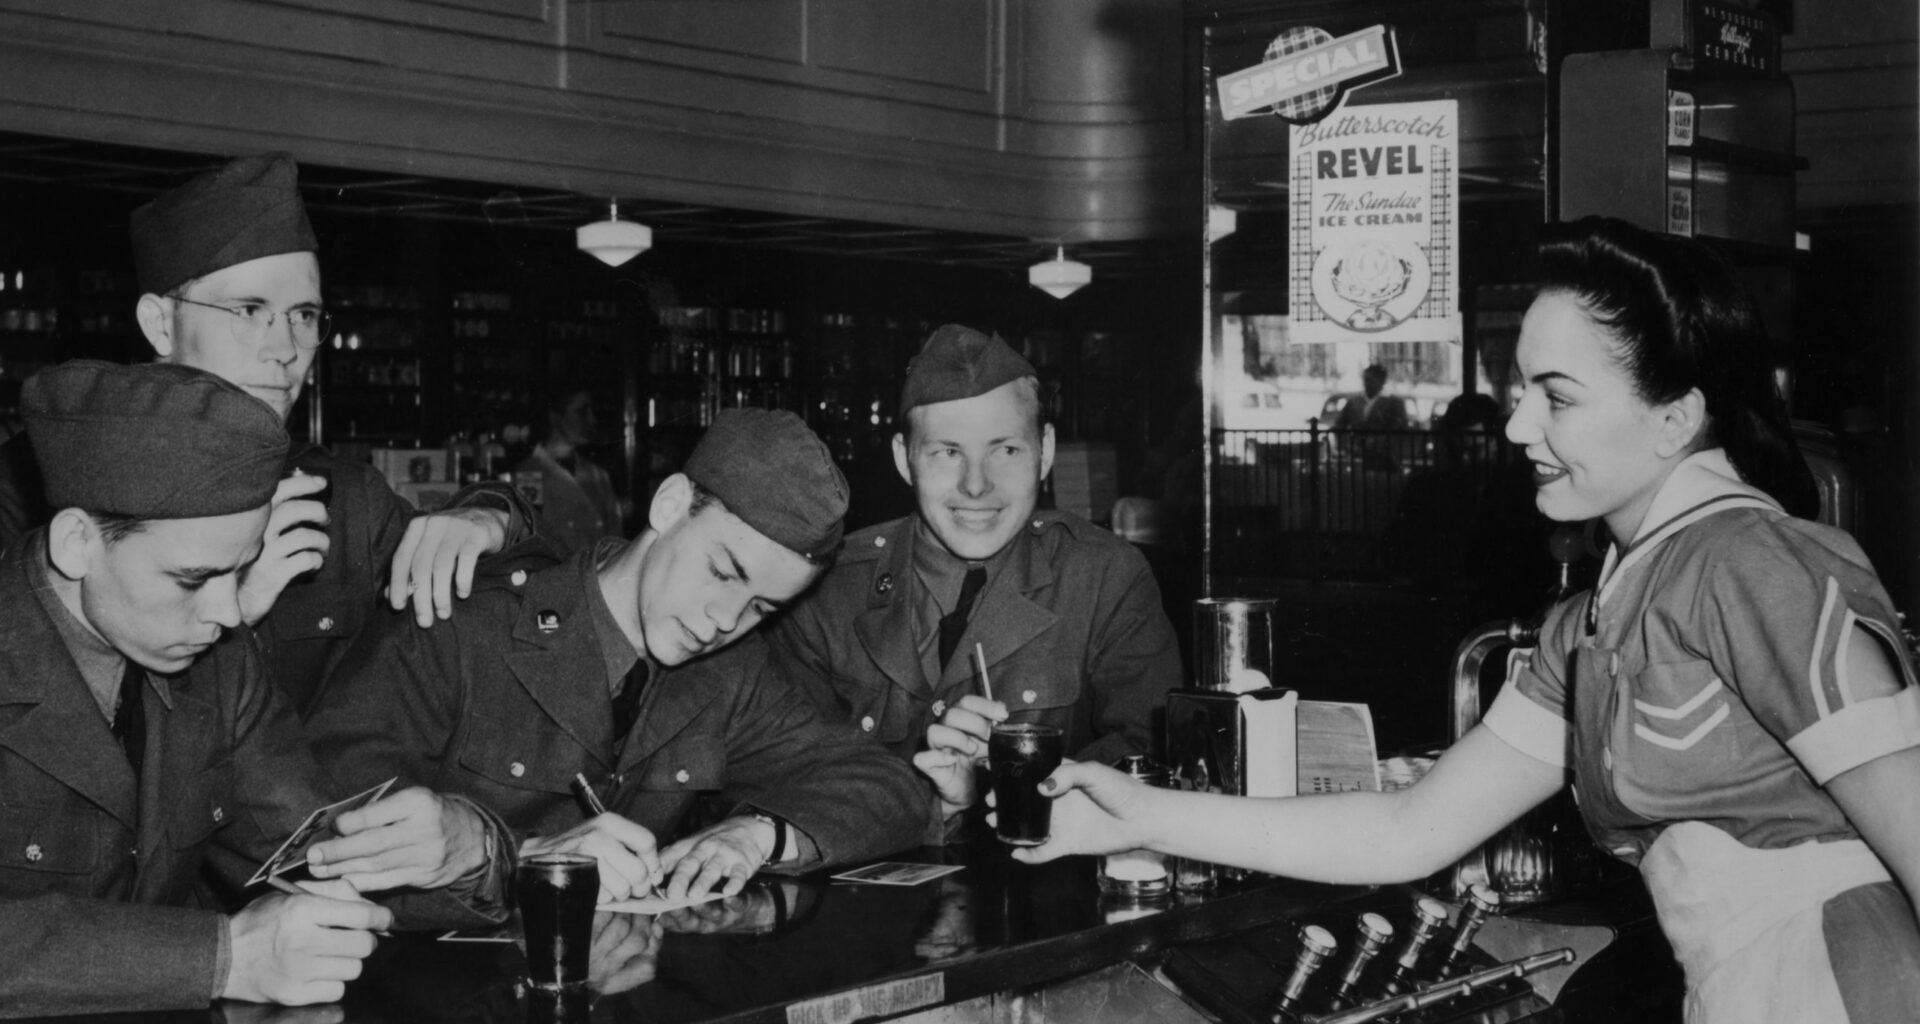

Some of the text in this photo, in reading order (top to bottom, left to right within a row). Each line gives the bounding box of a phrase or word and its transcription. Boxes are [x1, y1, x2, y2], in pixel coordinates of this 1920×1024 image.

[1229, 38, 1379, 103] SPECIAL
[1705, 43, 1765, 70] CEREALS
[1295, 114, 1451, 148] Butterscotch
[1317, 145, 1424, 180] REVEL
[1322, 190, 1422, 213] The Sundae
[1319, 212, 1423, 228] ICE CREAM
